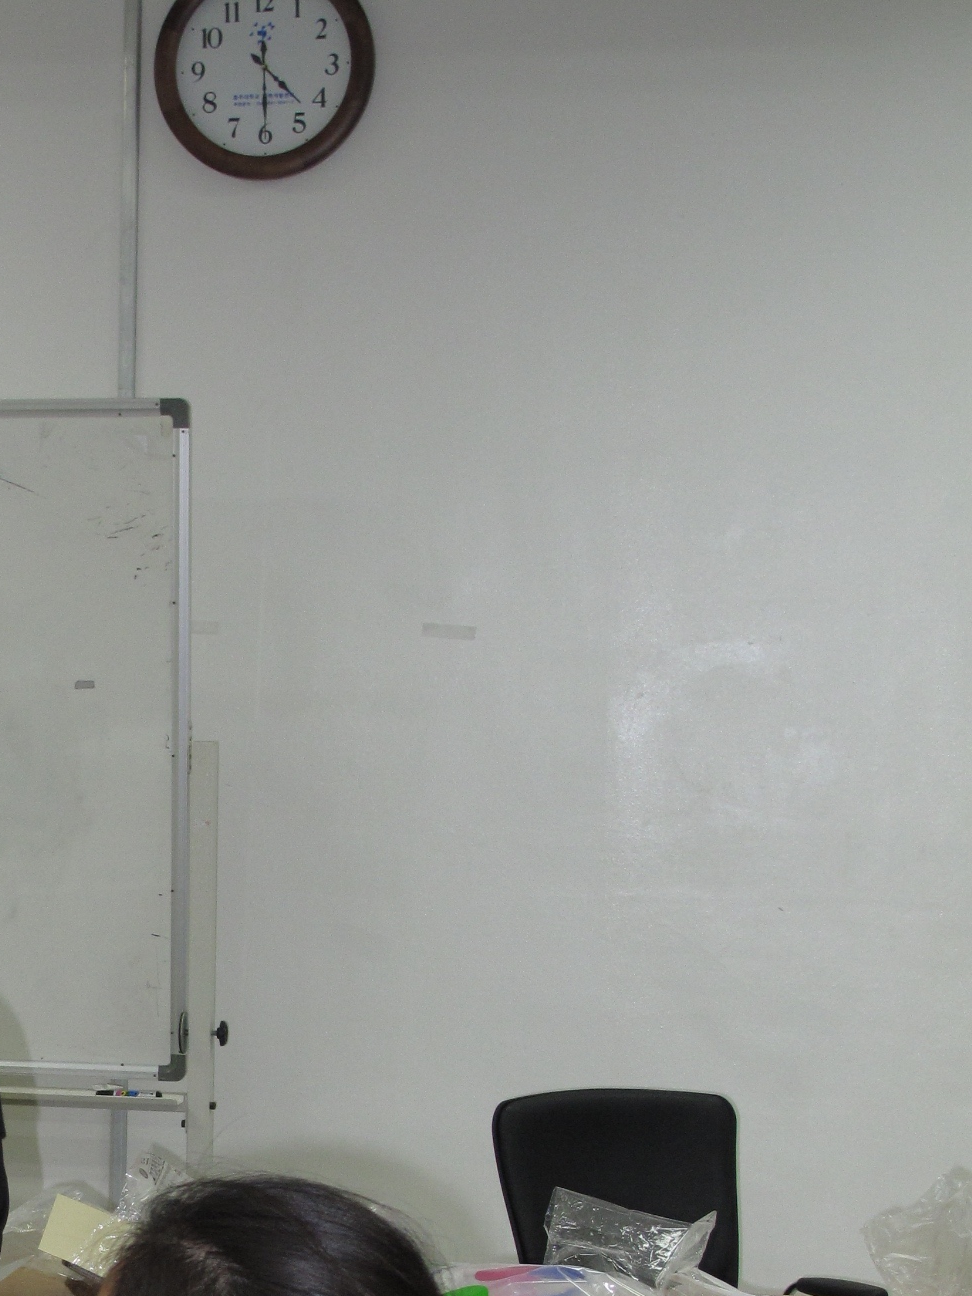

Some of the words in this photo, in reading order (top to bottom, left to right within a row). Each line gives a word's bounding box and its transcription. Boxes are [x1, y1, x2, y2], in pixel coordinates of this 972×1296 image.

[224, 2, 240, 23] 11
[256, 0, 274, 13] 12
[293, 0, 301, 18] 1
[201, 27, 223, 49] 10
[315, 18, 328, 39] 2
[191, 61, 206, 83] 9
[324, 53, 340, 75] 3
[202, 91, 217, 113] 8
[312, 87, 326, 108] 4
[228, 117, 241, 138] 7
[292, 112, 307, 133] 5
[258, 124, 272, 144] 6
